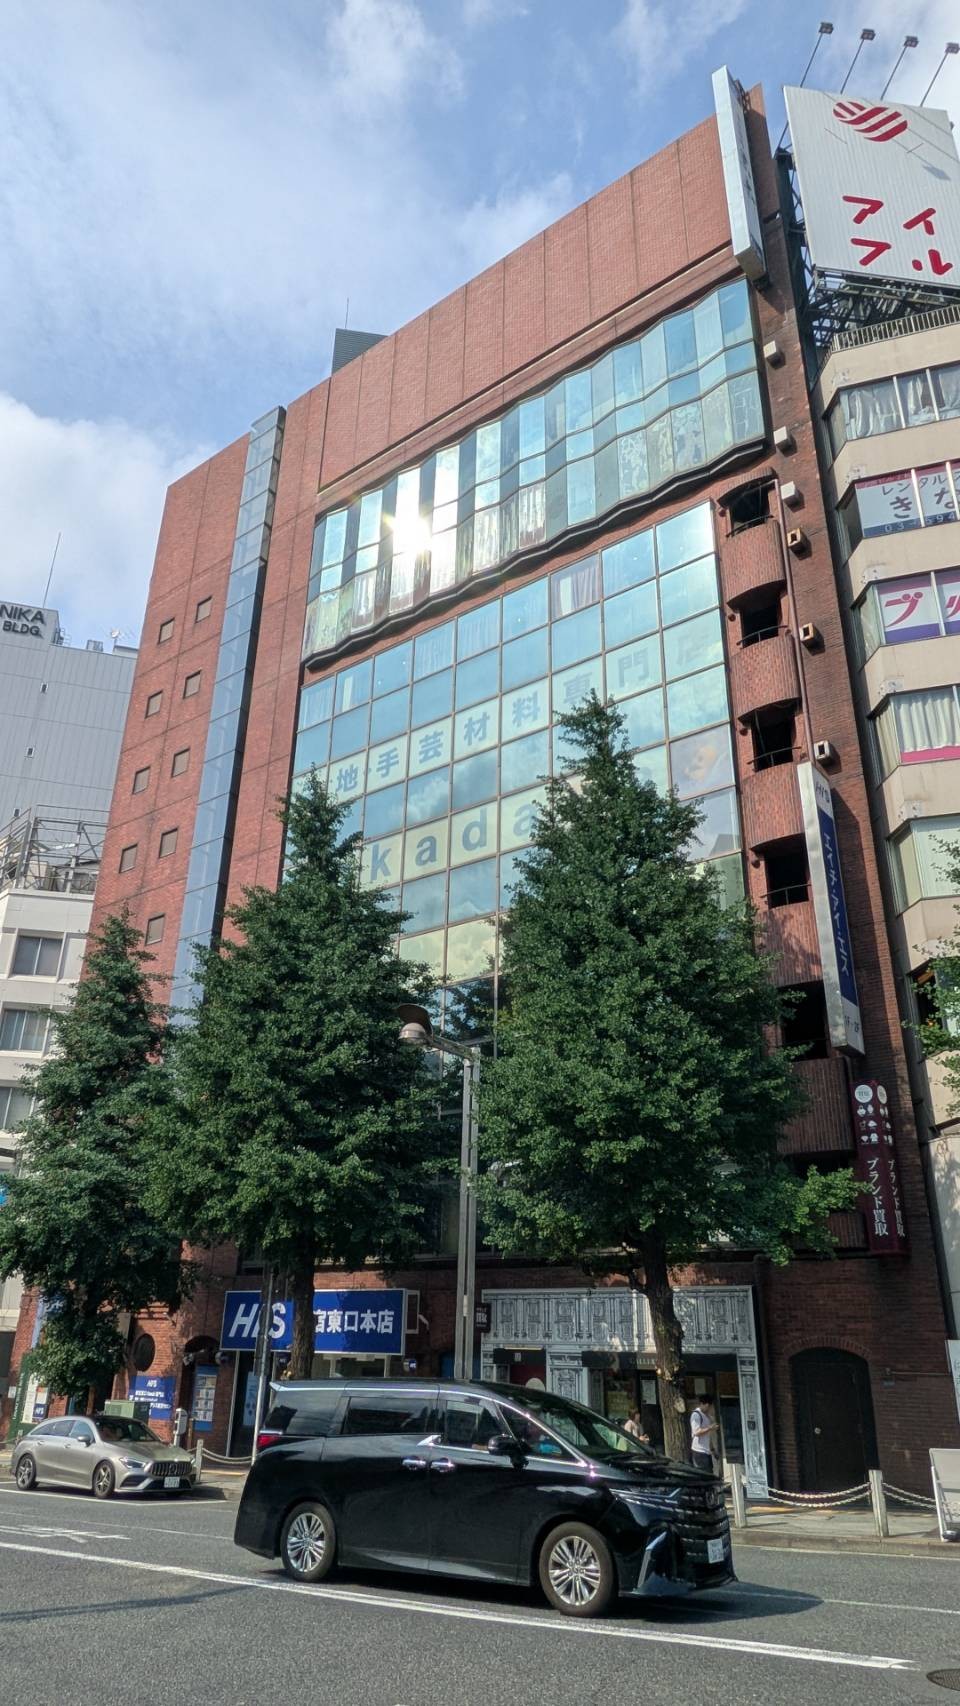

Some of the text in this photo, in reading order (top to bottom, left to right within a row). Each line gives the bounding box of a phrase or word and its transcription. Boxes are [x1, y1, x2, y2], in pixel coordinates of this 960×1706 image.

[0, 605, 45, 624] NIKA
[867, 1158, 889, 1236] ブランド買取
